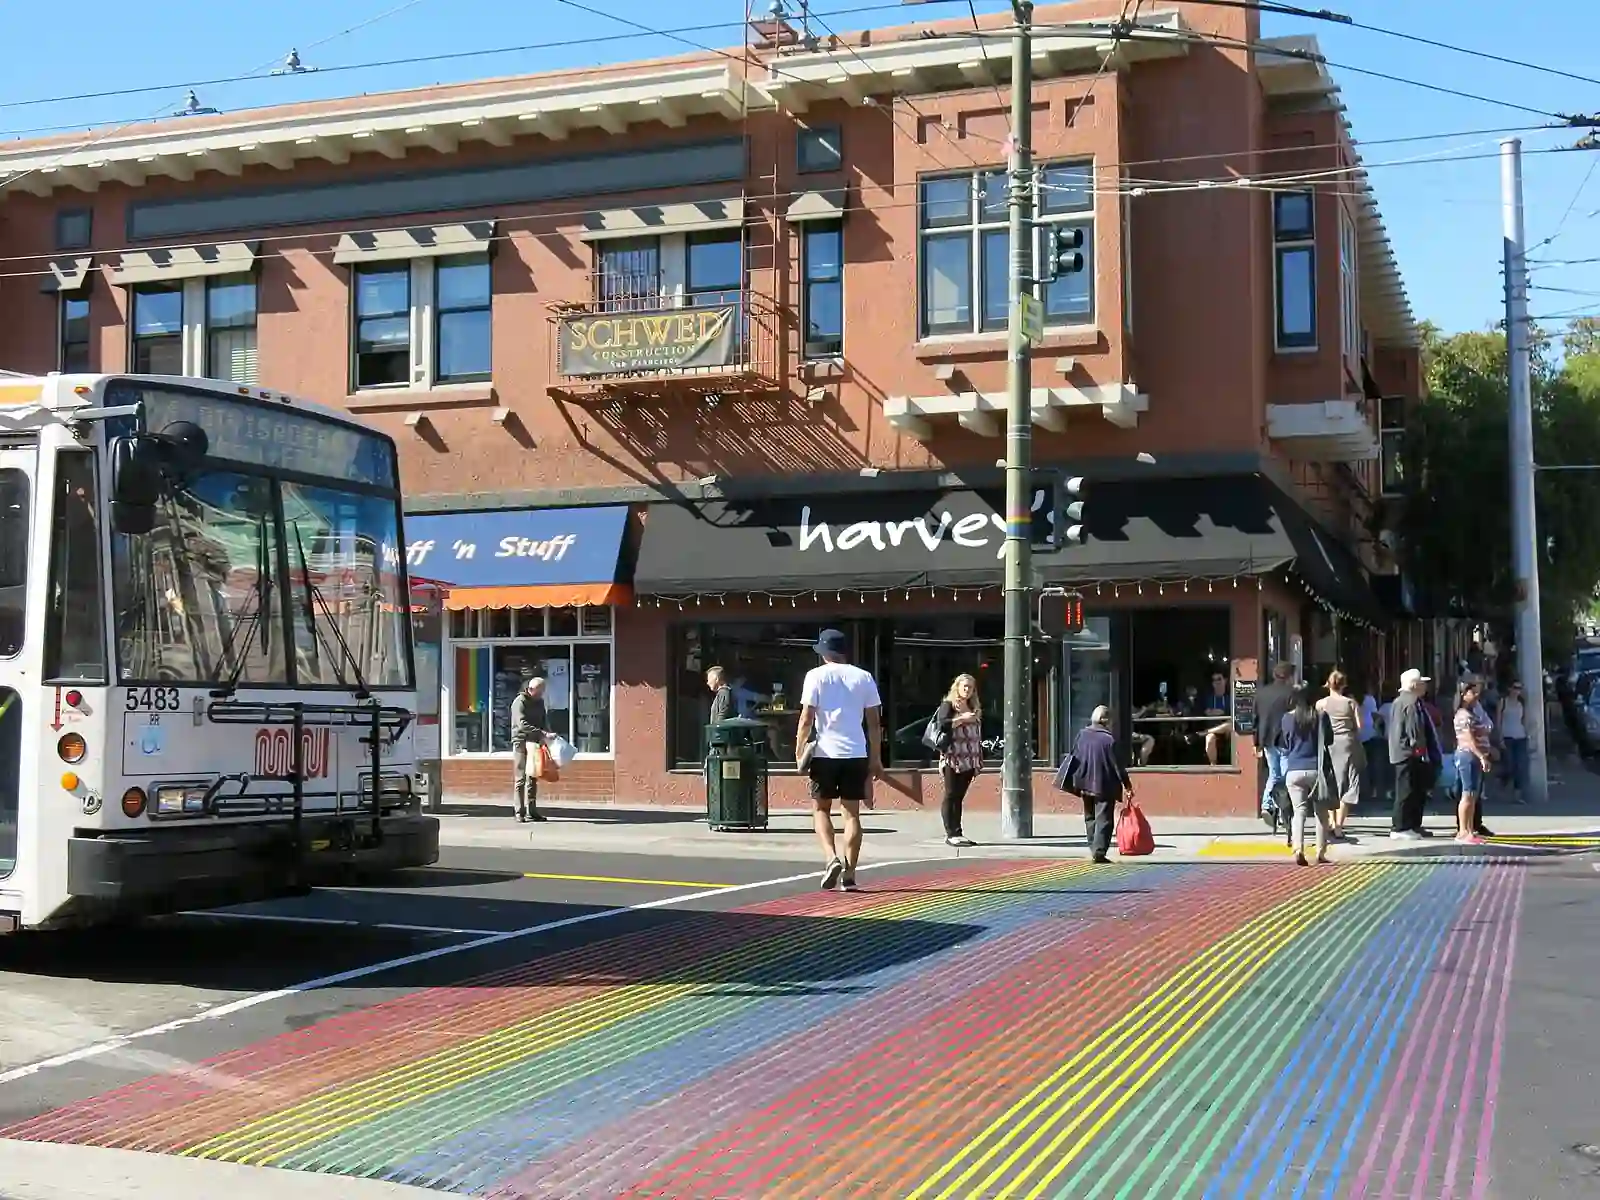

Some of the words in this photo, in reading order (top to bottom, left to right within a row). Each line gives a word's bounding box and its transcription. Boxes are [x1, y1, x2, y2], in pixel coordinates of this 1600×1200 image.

[571, 311, 724, 351] SCHWED
[592, 345, 696, 361] CONSTRUCTION
[494, 533, 577, 562] Stuff
[125, 687, 180, 711] 5483
